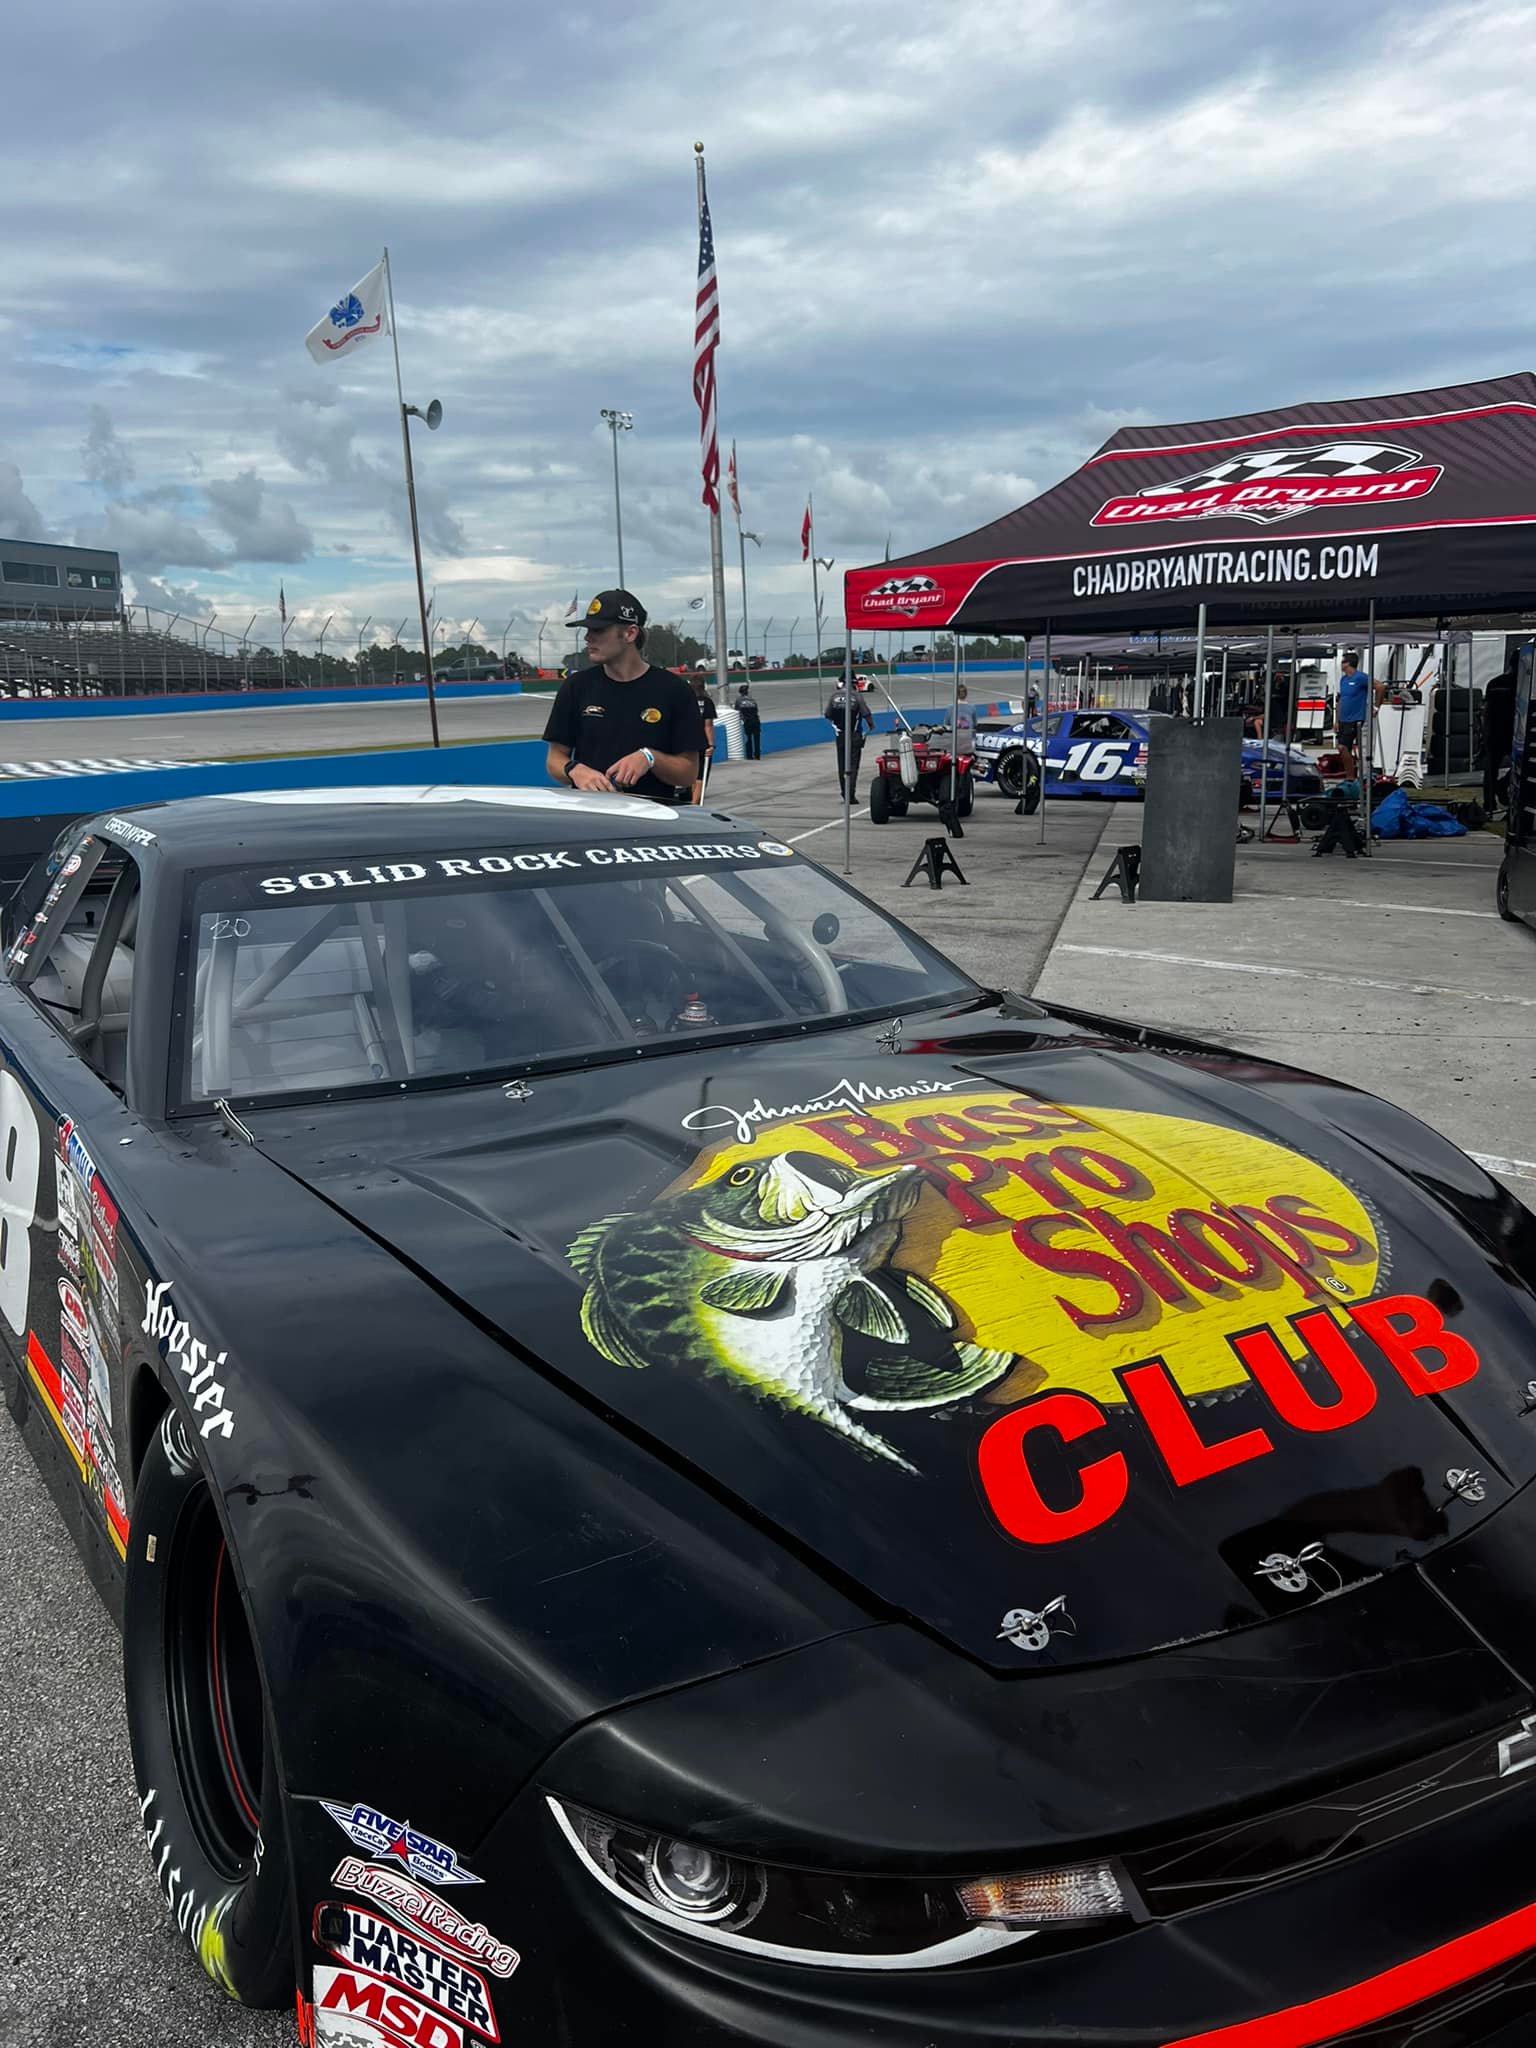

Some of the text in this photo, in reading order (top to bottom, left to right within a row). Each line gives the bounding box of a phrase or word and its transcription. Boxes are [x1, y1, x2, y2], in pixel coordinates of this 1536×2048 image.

[1104, 479, 1427, 518] Chad Bryant
[864, 594, 942, 607] Chad Bryant
[1072, 543, 1380, 597] CHADBRYANTRACING.COM
[1064, 742, 1131, 781] 16
[260, 862, 427, 896] SOLID
[441, 850, 584, 878] ROCK
[585, 843, 761, 866] CARRIERS
[800, 1095, 1081, 1169] Bass
[917, 1140, 1134, 1226] Pro
[1010, 1192, 1363, 1330] Shops
[977, 1294, 1481, 1546] CLUB
[352, 1807, 454, 1872] FIVE STAR
[412, 1855, 446, 1879] Bodies
[320, 1973, 461, 2048] MSD
[354, 1937, 491, 2033] MASTER
